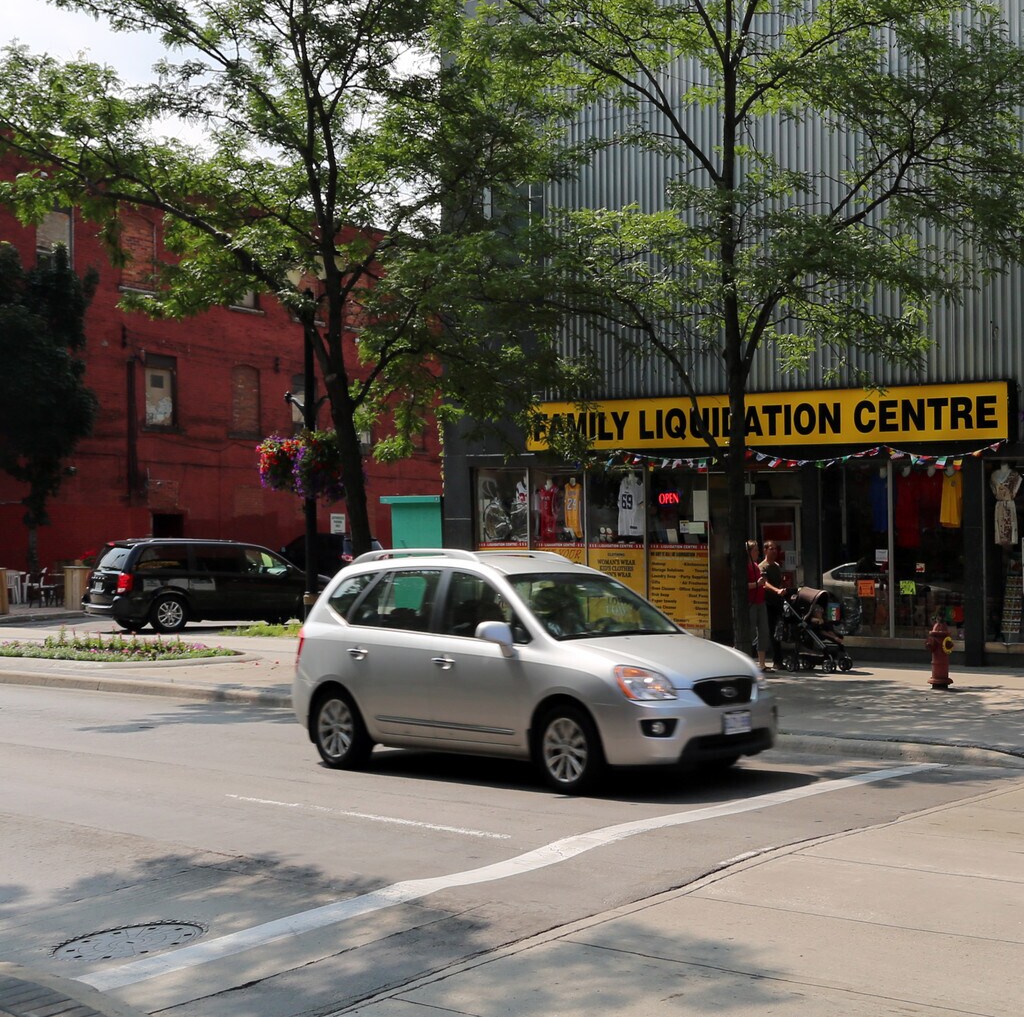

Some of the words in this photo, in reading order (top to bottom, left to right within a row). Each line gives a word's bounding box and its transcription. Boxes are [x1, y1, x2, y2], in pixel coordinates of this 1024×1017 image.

[854, 395, 998, 433] CENTRE
[621, 494, 633, 510] 69
[658, 492, 680, 504] OPEN
